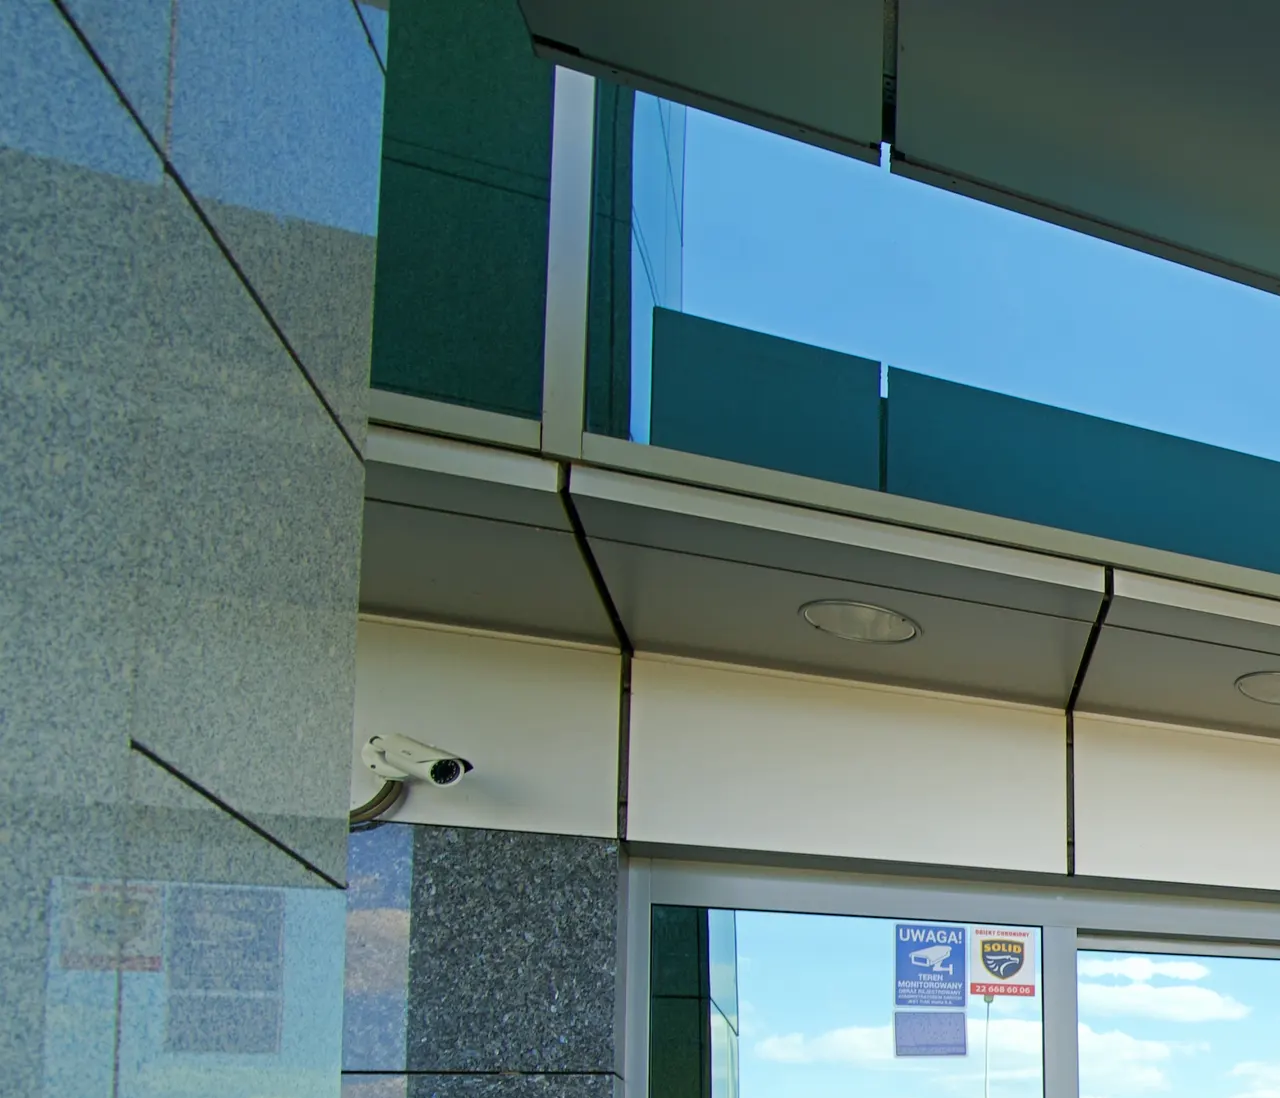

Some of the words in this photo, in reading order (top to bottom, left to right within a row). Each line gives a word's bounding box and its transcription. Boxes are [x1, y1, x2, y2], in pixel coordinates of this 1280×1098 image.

[899, 927, 963, 945] UWAGA!
[983, 942, 1022, 954] SOLID
[918, 973, 944, 982] TEREN
[898, 980, 963, 990] MONITOROWANY
[975, 985, 987, 993] 22
[988, 985, 1005, 994] 668
[1006, 986, 1018, 994] 60
[1019, 987, 1031, 995] 06
